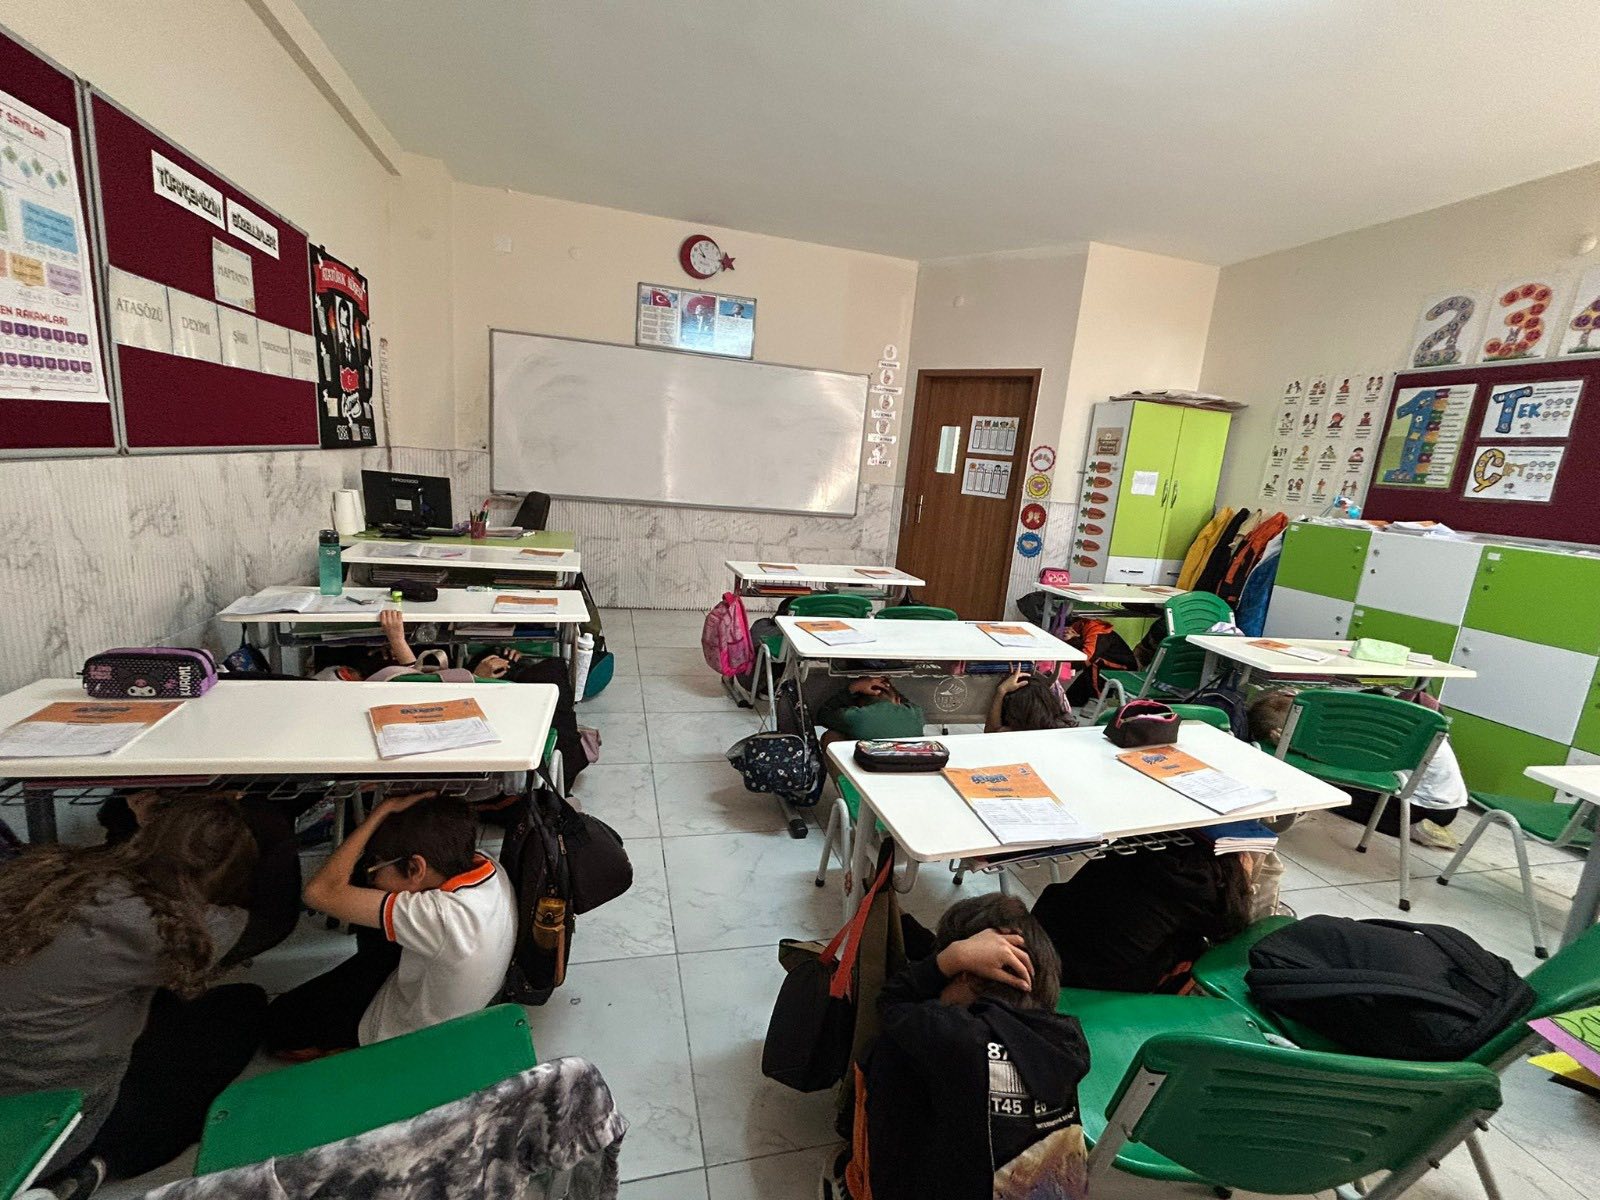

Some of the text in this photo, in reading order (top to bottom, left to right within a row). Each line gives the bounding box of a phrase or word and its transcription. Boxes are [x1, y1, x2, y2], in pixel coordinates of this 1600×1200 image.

[15, 307, 69, 326] RAKAMLARI
[115, 298, 163, 322] ATASÖZÜ
[179, 666, 191, 696] KUROMI
[991, 1097, 1023, 1114] T45
